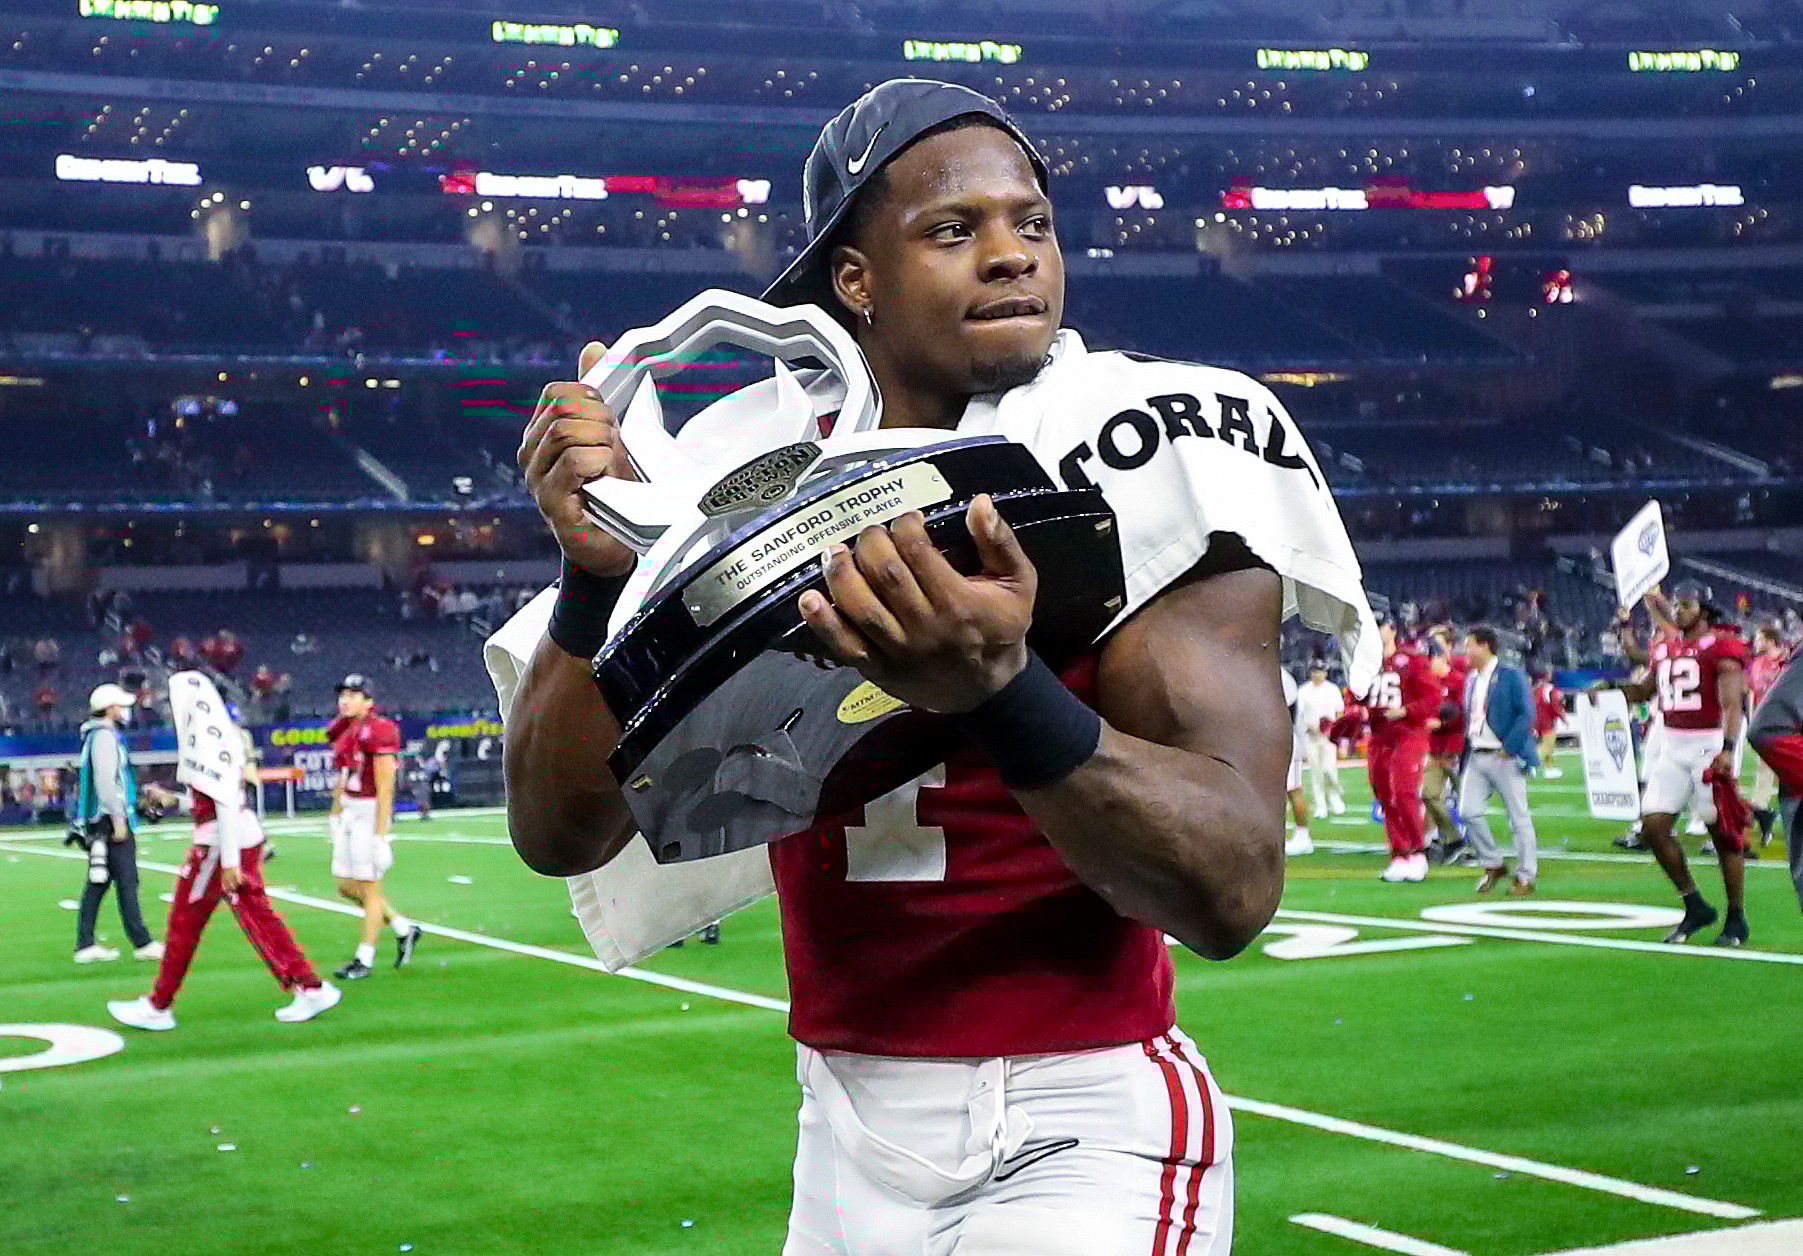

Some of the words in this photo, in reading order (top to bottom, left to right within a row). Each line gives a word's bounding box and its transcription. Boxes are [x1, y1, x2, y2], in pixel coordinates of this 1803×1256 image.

[715, 558, 748, 586] THE
[751, 509, 834, 563] SANFORD
[836, 477, 905, 513] TROPHY
[736, 541, 806, 590] OUTSTANDING
[807, 513, 862, 547] OFFENSIVE
[863, 496, 904, 519] PLAYER
[1657, 657, 1702, 711] 12
